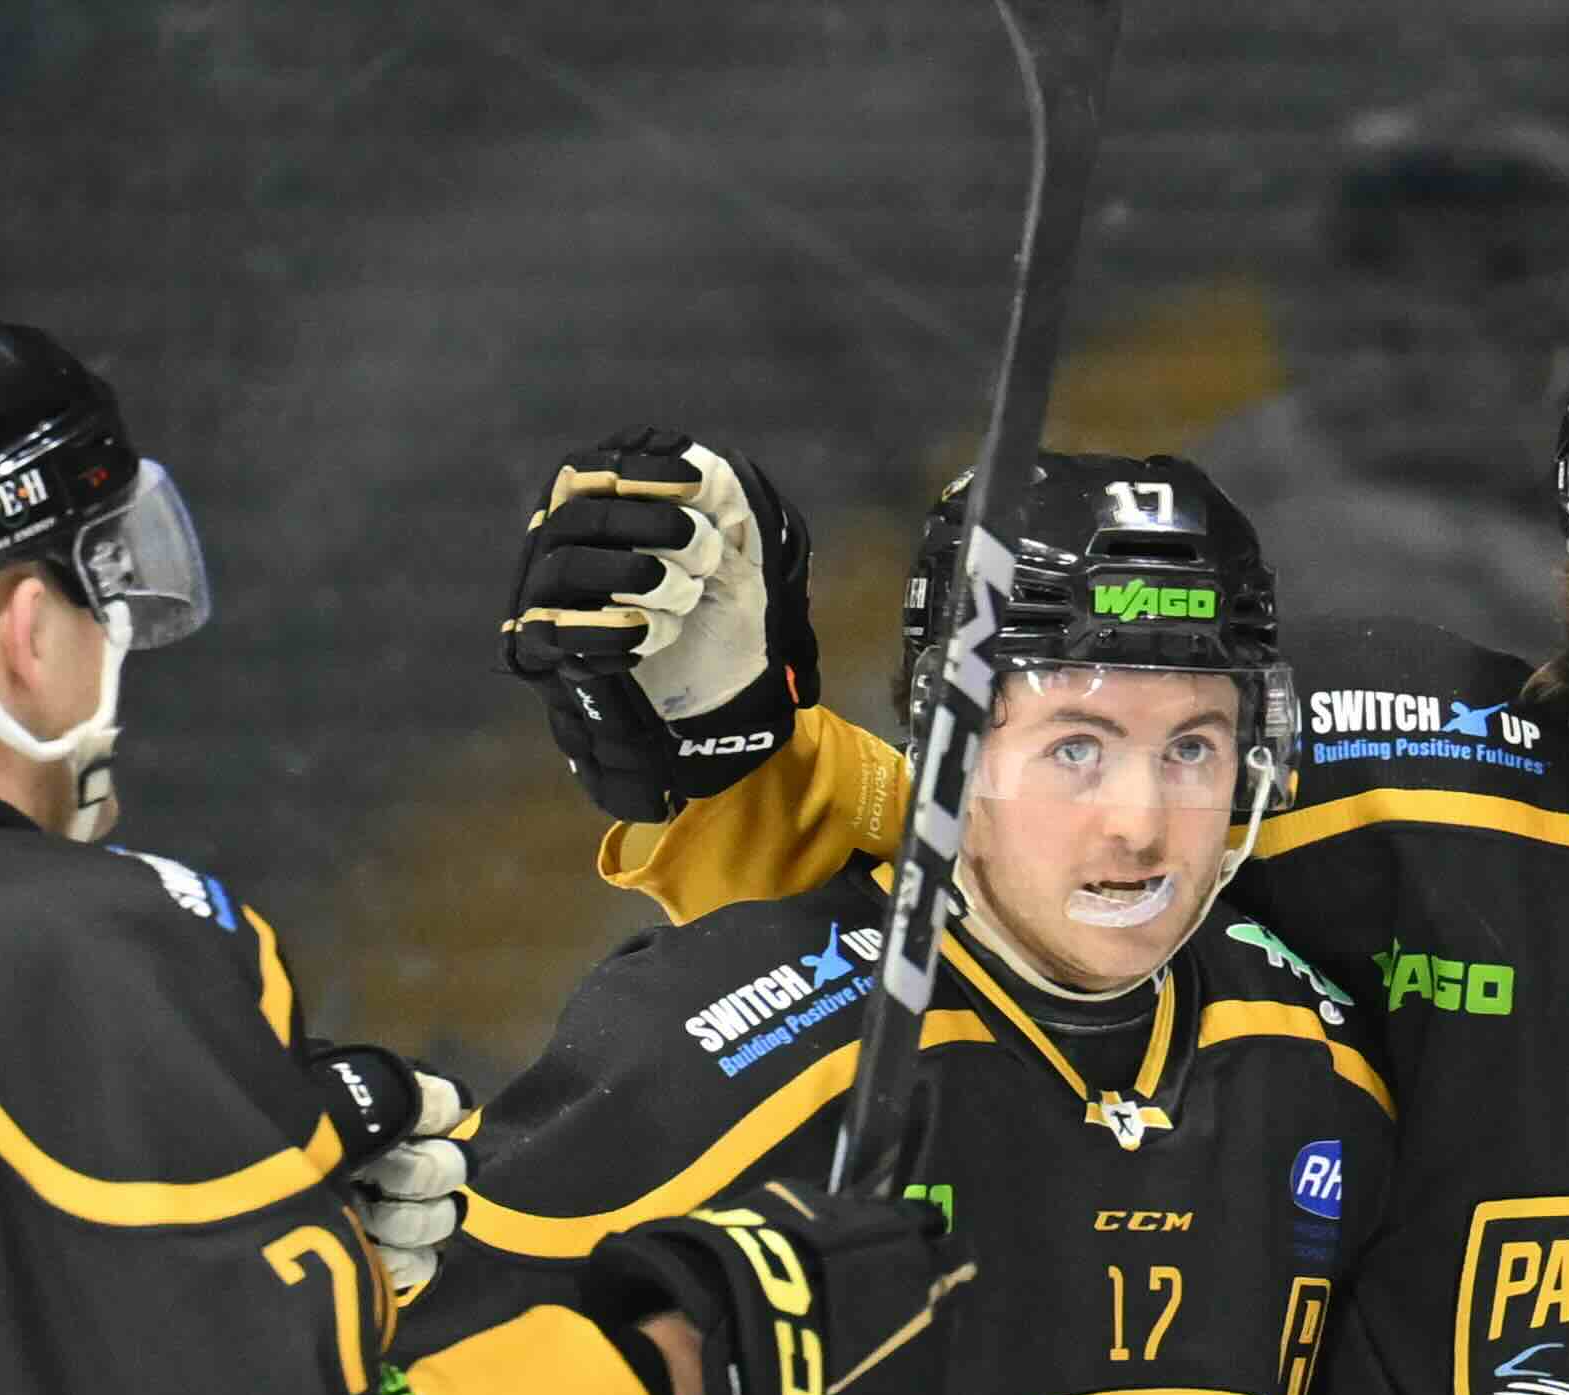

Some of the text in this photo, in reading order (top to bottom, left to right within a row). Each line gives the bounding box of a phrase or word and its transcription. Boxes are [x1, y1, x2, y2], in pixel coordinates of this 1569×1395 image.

[1103, 480, 1174, 524] 17
[1093, 578, 1217, 624] WAGO
[1309, 690, 1541, 750] SWITCH UP
[1313, 737, 1545, 776] Building Positive Futures
[684, 963, 816, 1053] SWITCH
[718, 987, 858, 1079] Building Positive
[1092, 1209, 1194, 1234] CCM
[1106, 1264, 1184, 1363] 17
